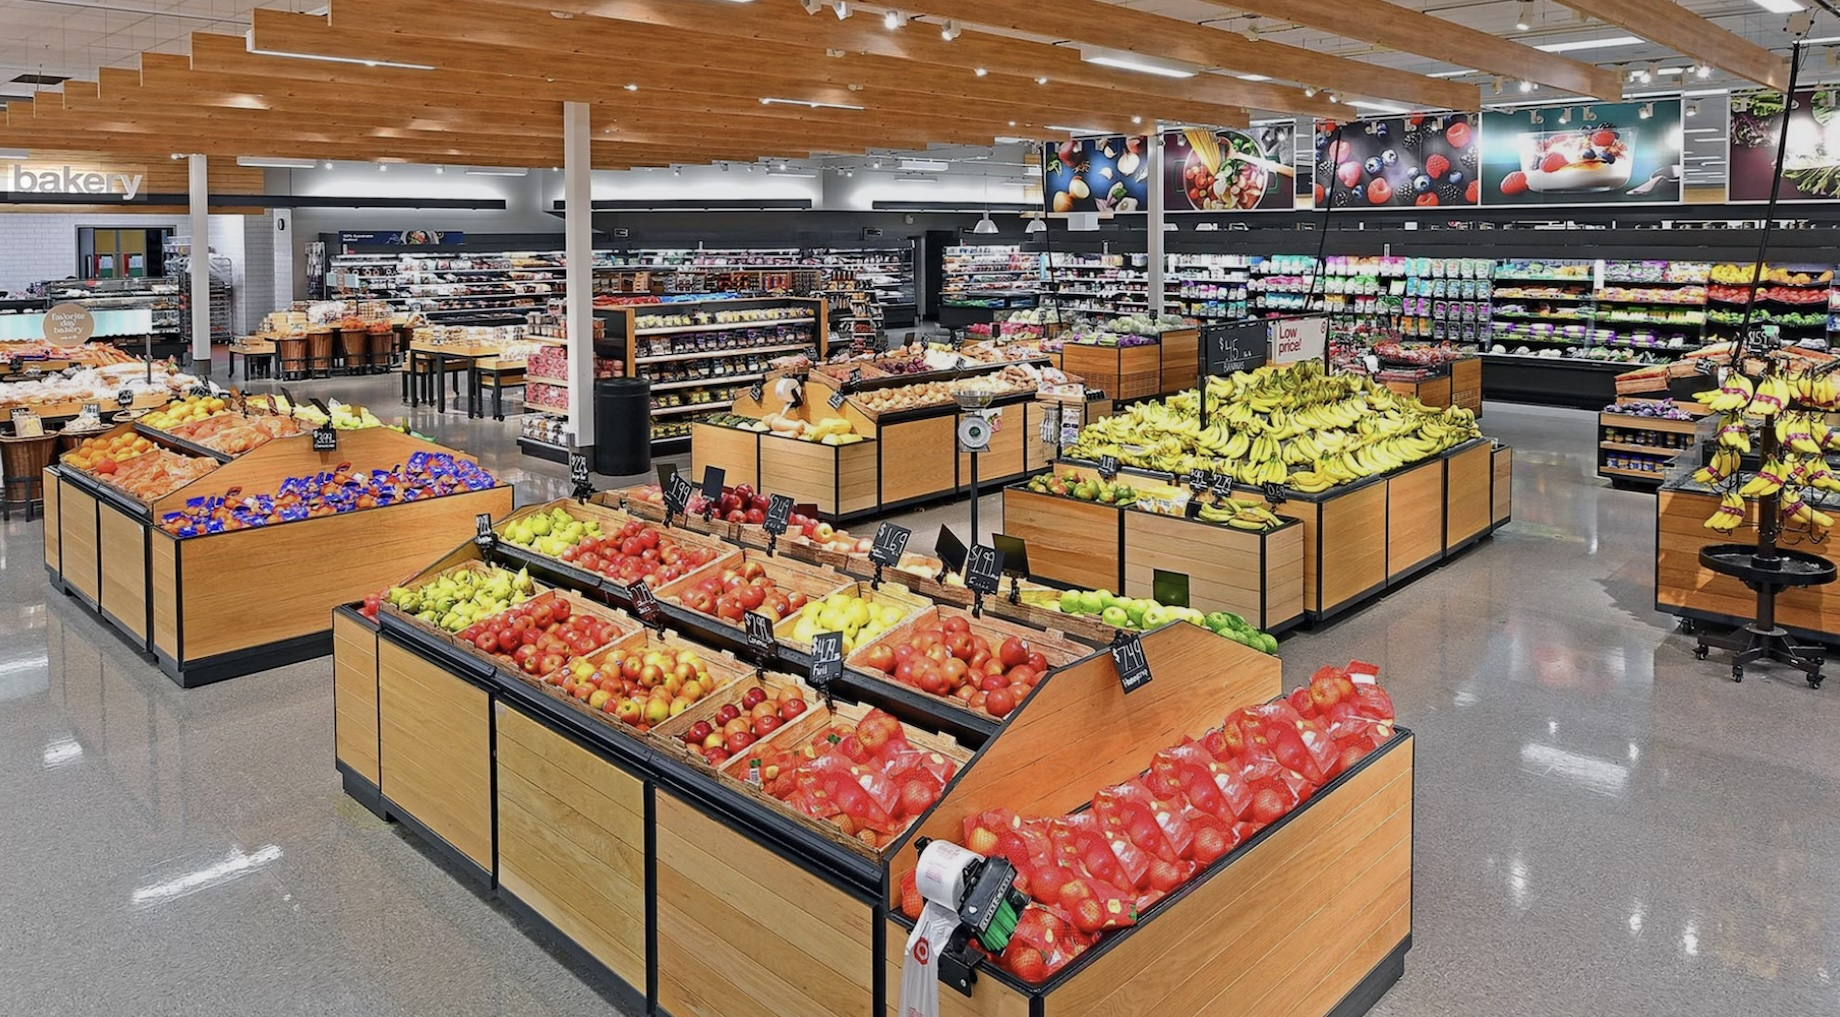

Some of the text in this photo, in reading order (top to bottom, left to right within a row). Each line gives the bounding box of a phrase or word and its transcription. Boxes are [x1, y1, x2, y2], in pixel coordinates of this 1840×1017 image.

[14, 164, 143, 200] bakery
[51, 312, 85, 321] favorite
[60, 319, 77, 329] day
[1279, 326, 1297, 339] Low
[1279, 339, 1301, 356] price!
